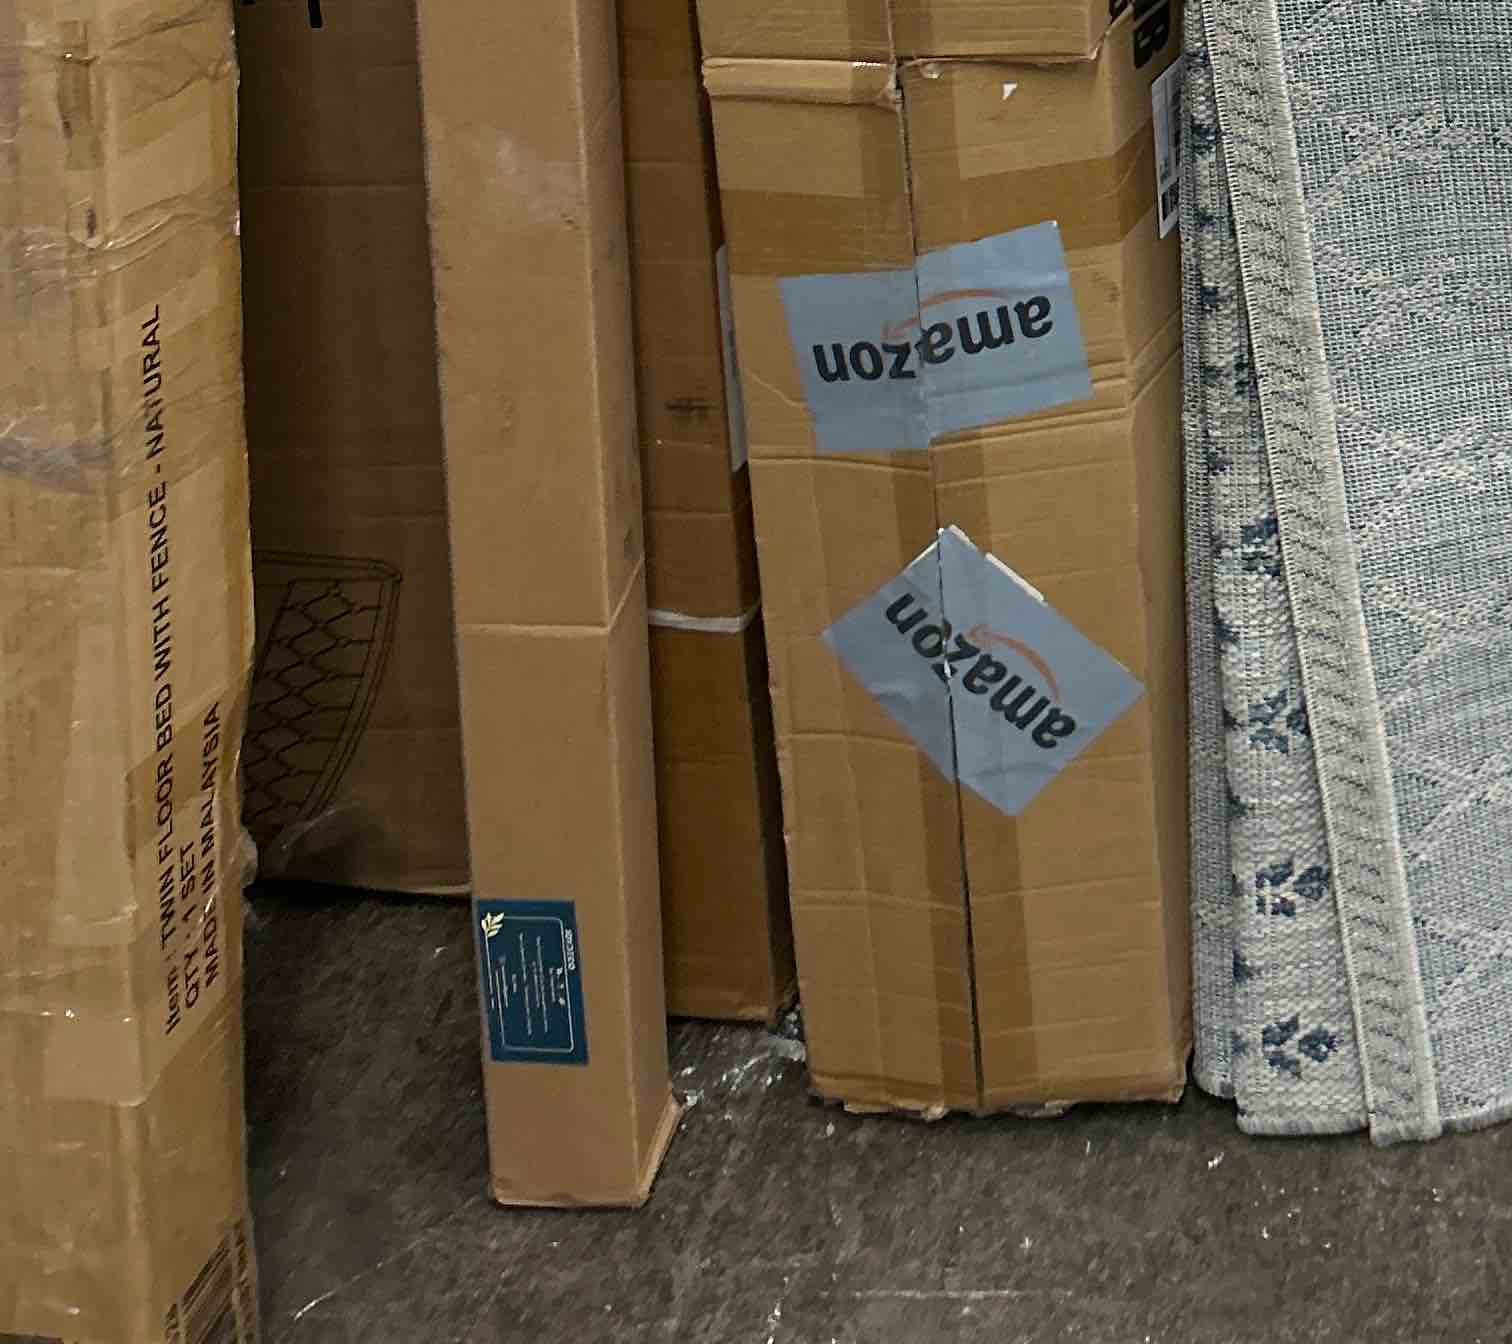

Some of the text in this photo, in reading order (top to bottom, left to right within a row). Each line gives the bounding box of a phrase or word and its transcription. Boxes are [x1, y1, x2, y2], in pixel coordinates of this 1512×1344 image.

[141, 303, 165, 460] NATURAL
[812, 295, 1053, 384] amazon
[148, 481, 170, 591] FENCE
[153, 595, 171, 678] WITH
[885, 591, 1077, 750] amazon
[155, 681, 173, 752] BED
[157, 754, 173, 864] FLOOR
[200, 701, 221, 858] MALAYSIA
[159, 865, 177, 950] TWIN
[181, 840, 195, 900] SET
[202, 860, 216, 893] IN
